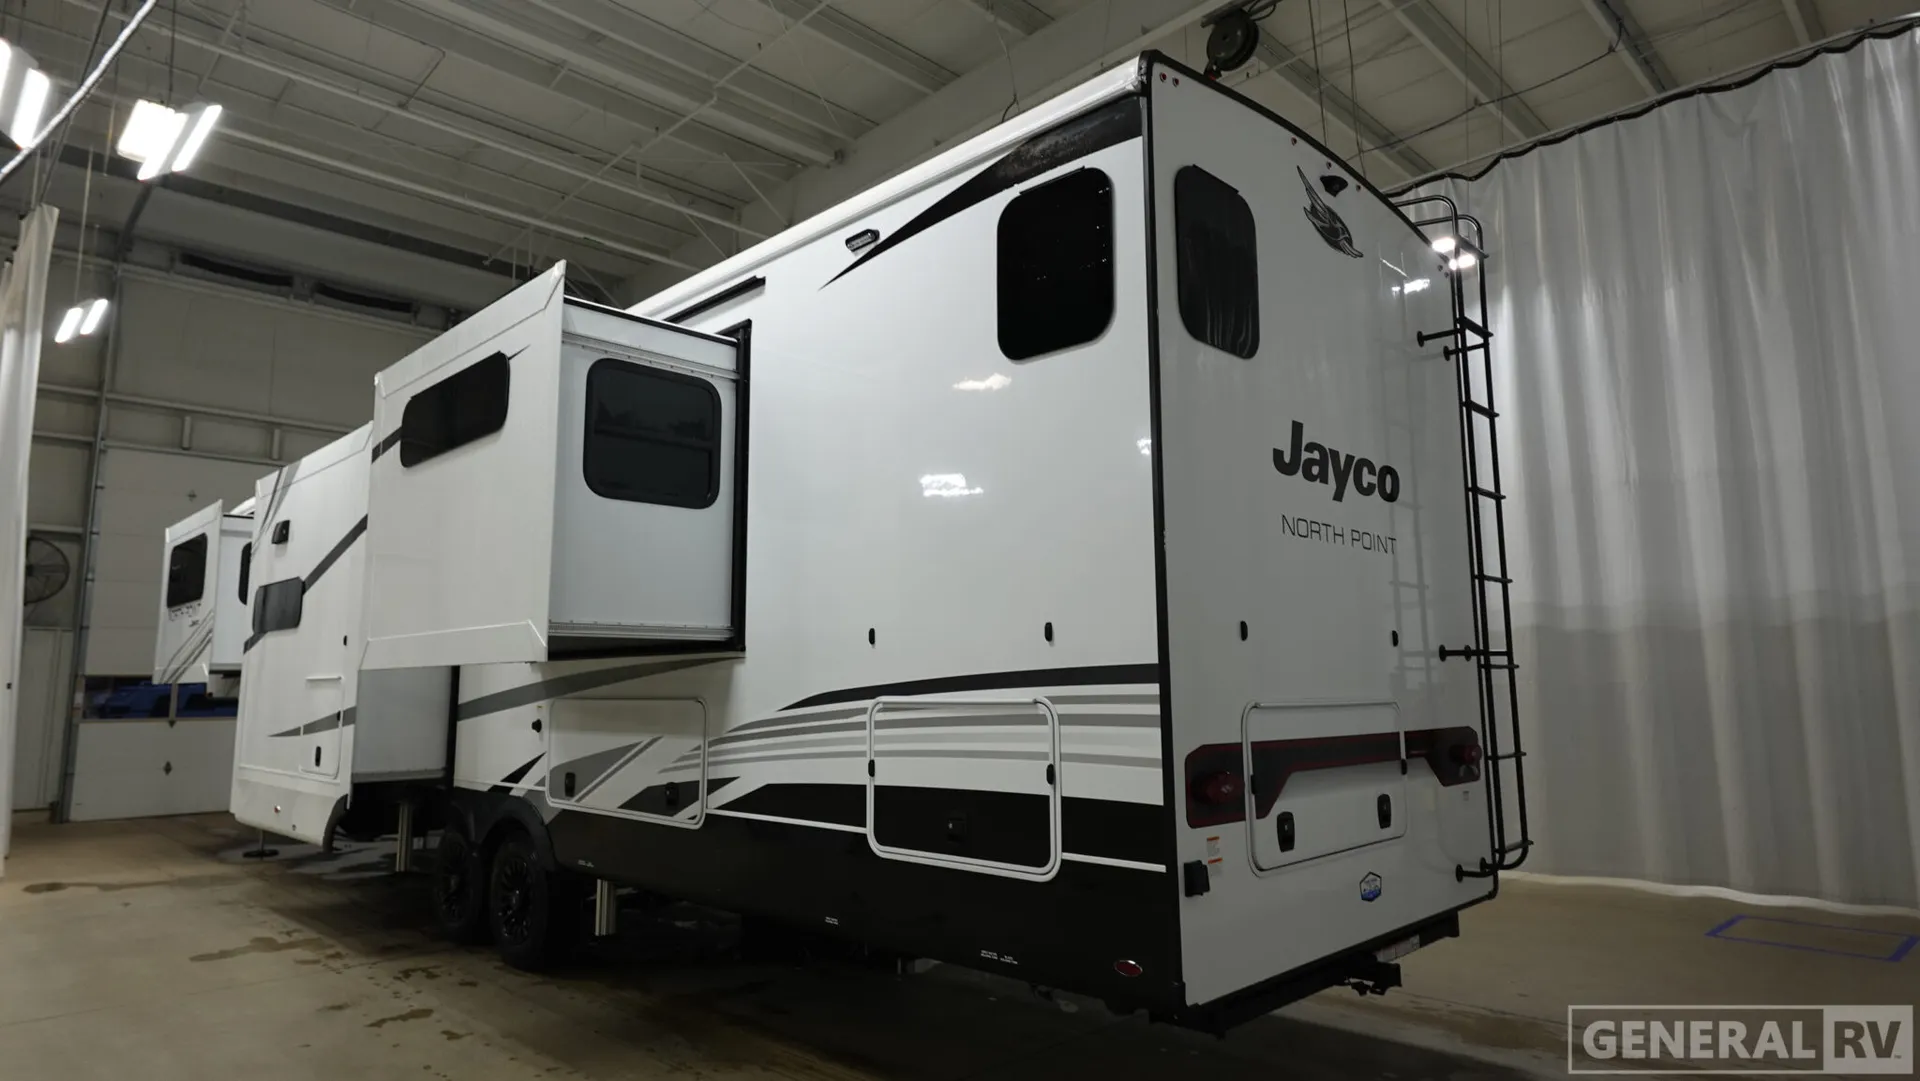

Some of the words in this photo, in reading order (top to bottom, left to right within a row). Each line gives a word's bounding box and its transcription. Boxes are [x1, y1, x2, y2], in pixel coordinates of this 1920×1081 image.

[1272, 419, 1400, 503] Jayco
[1281, 514, 1345, 546] NORTH
[1351, 529, 1397, 555] POINT
